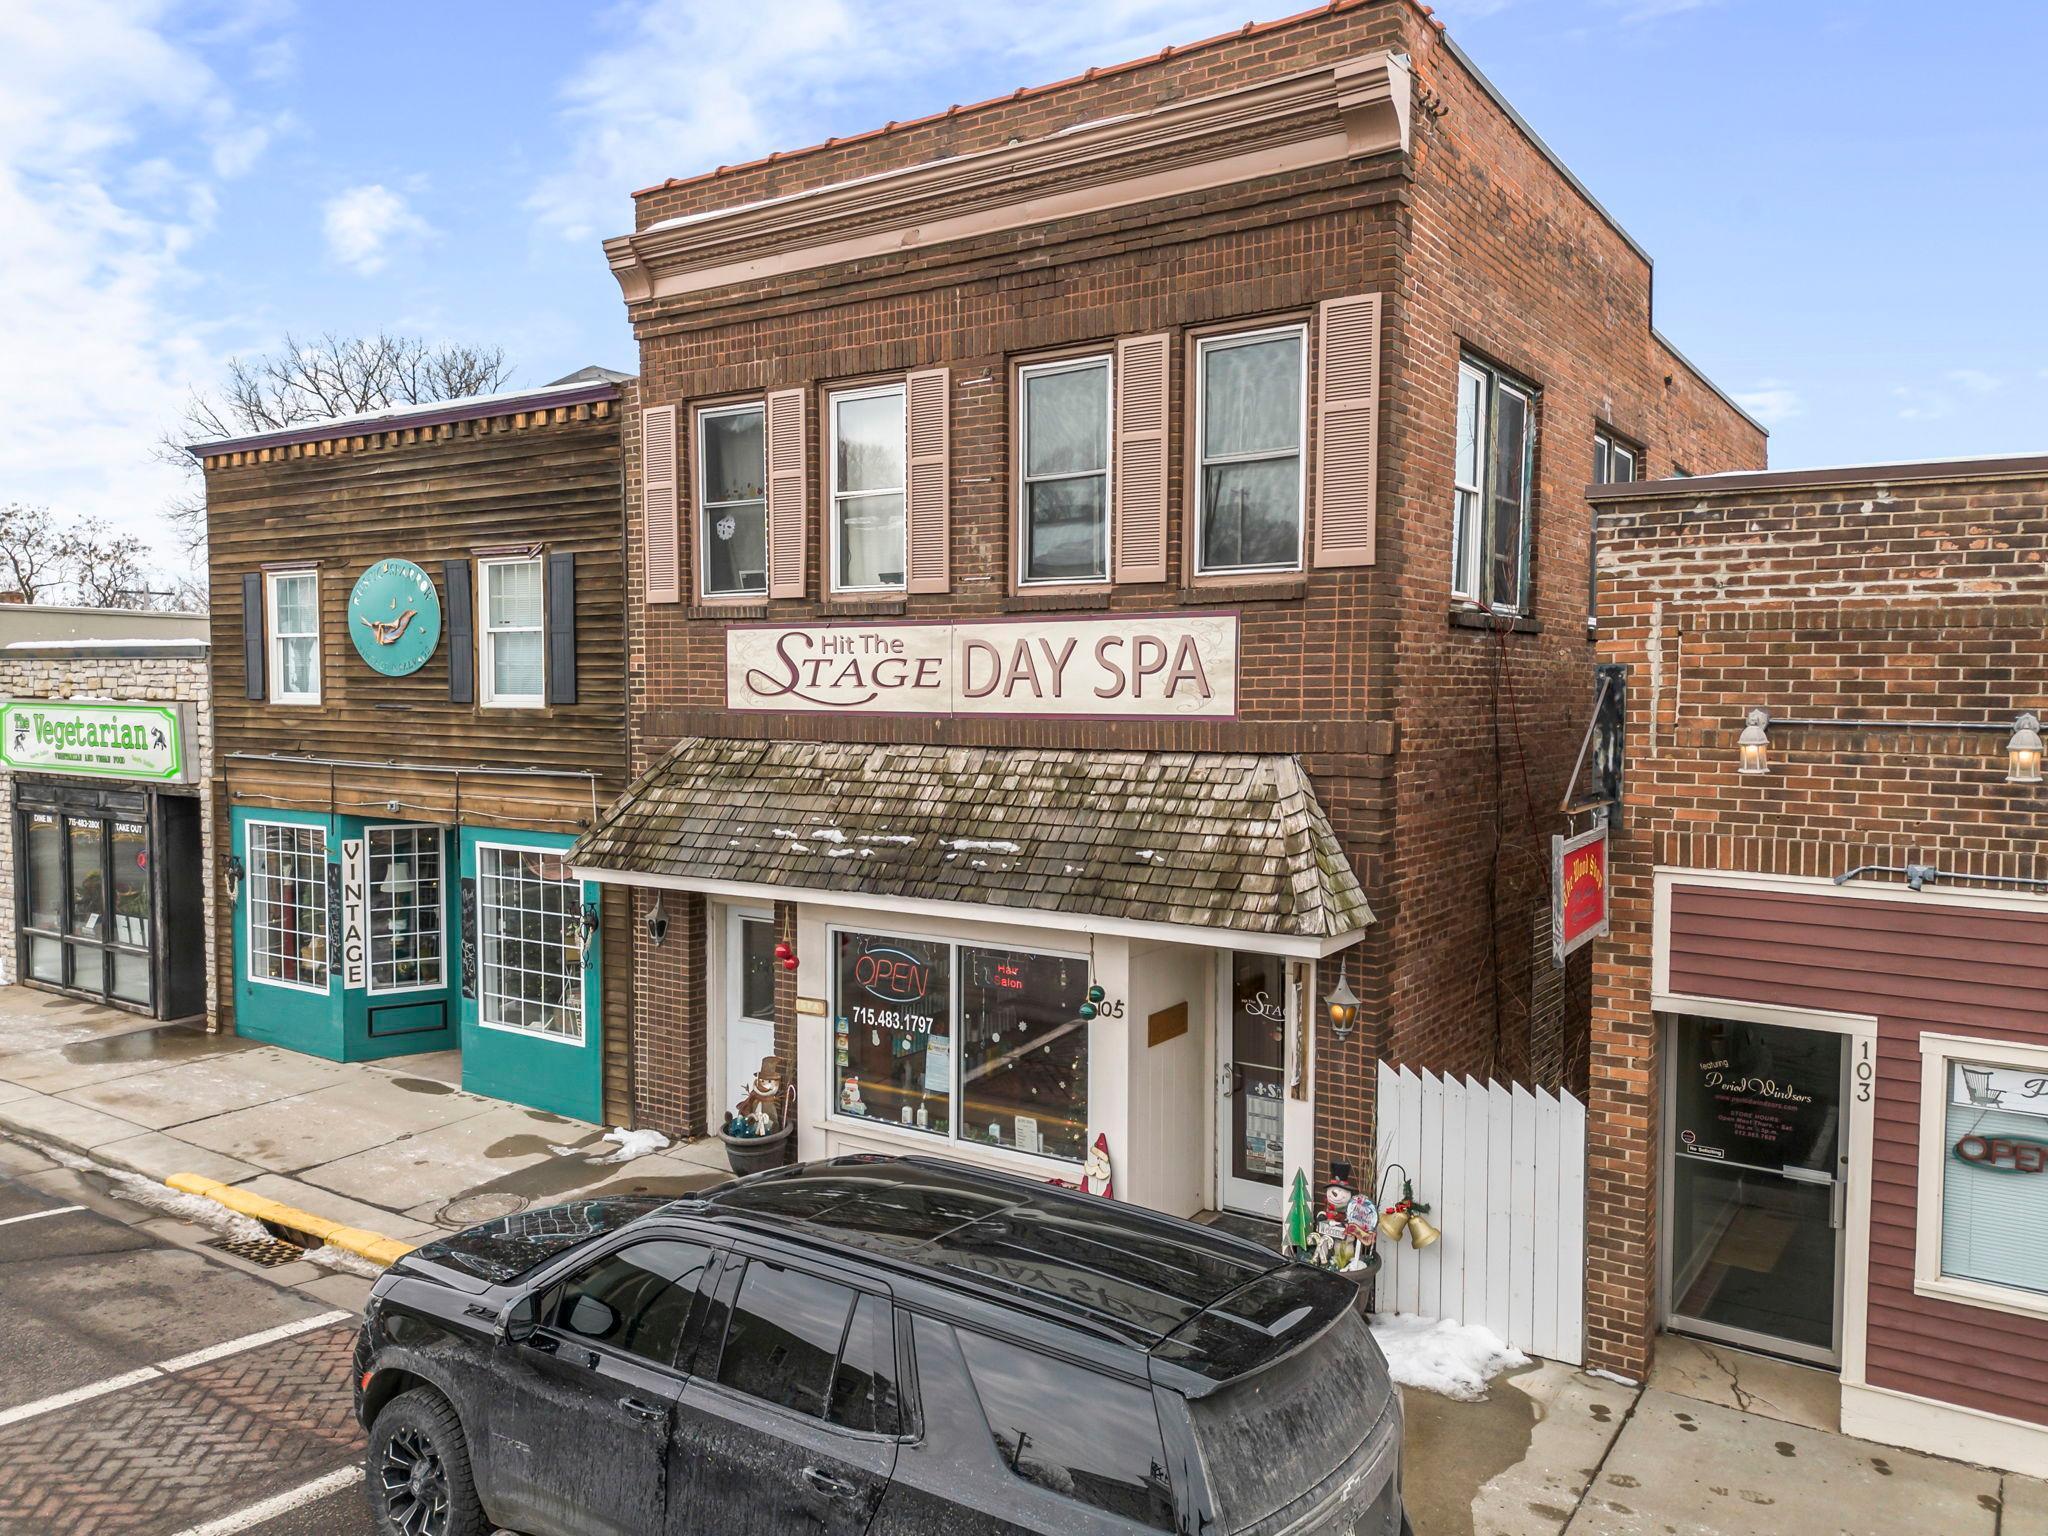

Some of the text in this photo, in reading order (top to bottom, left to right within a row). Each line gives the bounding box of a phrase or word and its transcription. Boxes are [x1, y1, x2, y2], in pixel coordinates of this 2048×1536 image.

[821, 634, 904, 654] Hit The
[961, 634, 1212, 699] DAY SPA
[14, 713, 30, 729] The
[33, 714, 148, 750] Vegetarian
[34, 814, 46, 822] DINE
[115, 823, 142, 833] TAKE OUT
[343, 843, 363, 983] VINTAGE
[855, 956, 929, 996] OPEN
[993, 975, 1023, 989] Salon
[997, 965, 1019, 976] Hair
[853, 1006, 934, 1034] 715.483.1797
[1700, 1059, 1729, 1070] featuring
[1856, 1041, 1872, 1102] 103
[1704, 1071, 1812, 1103] Period Windsors
